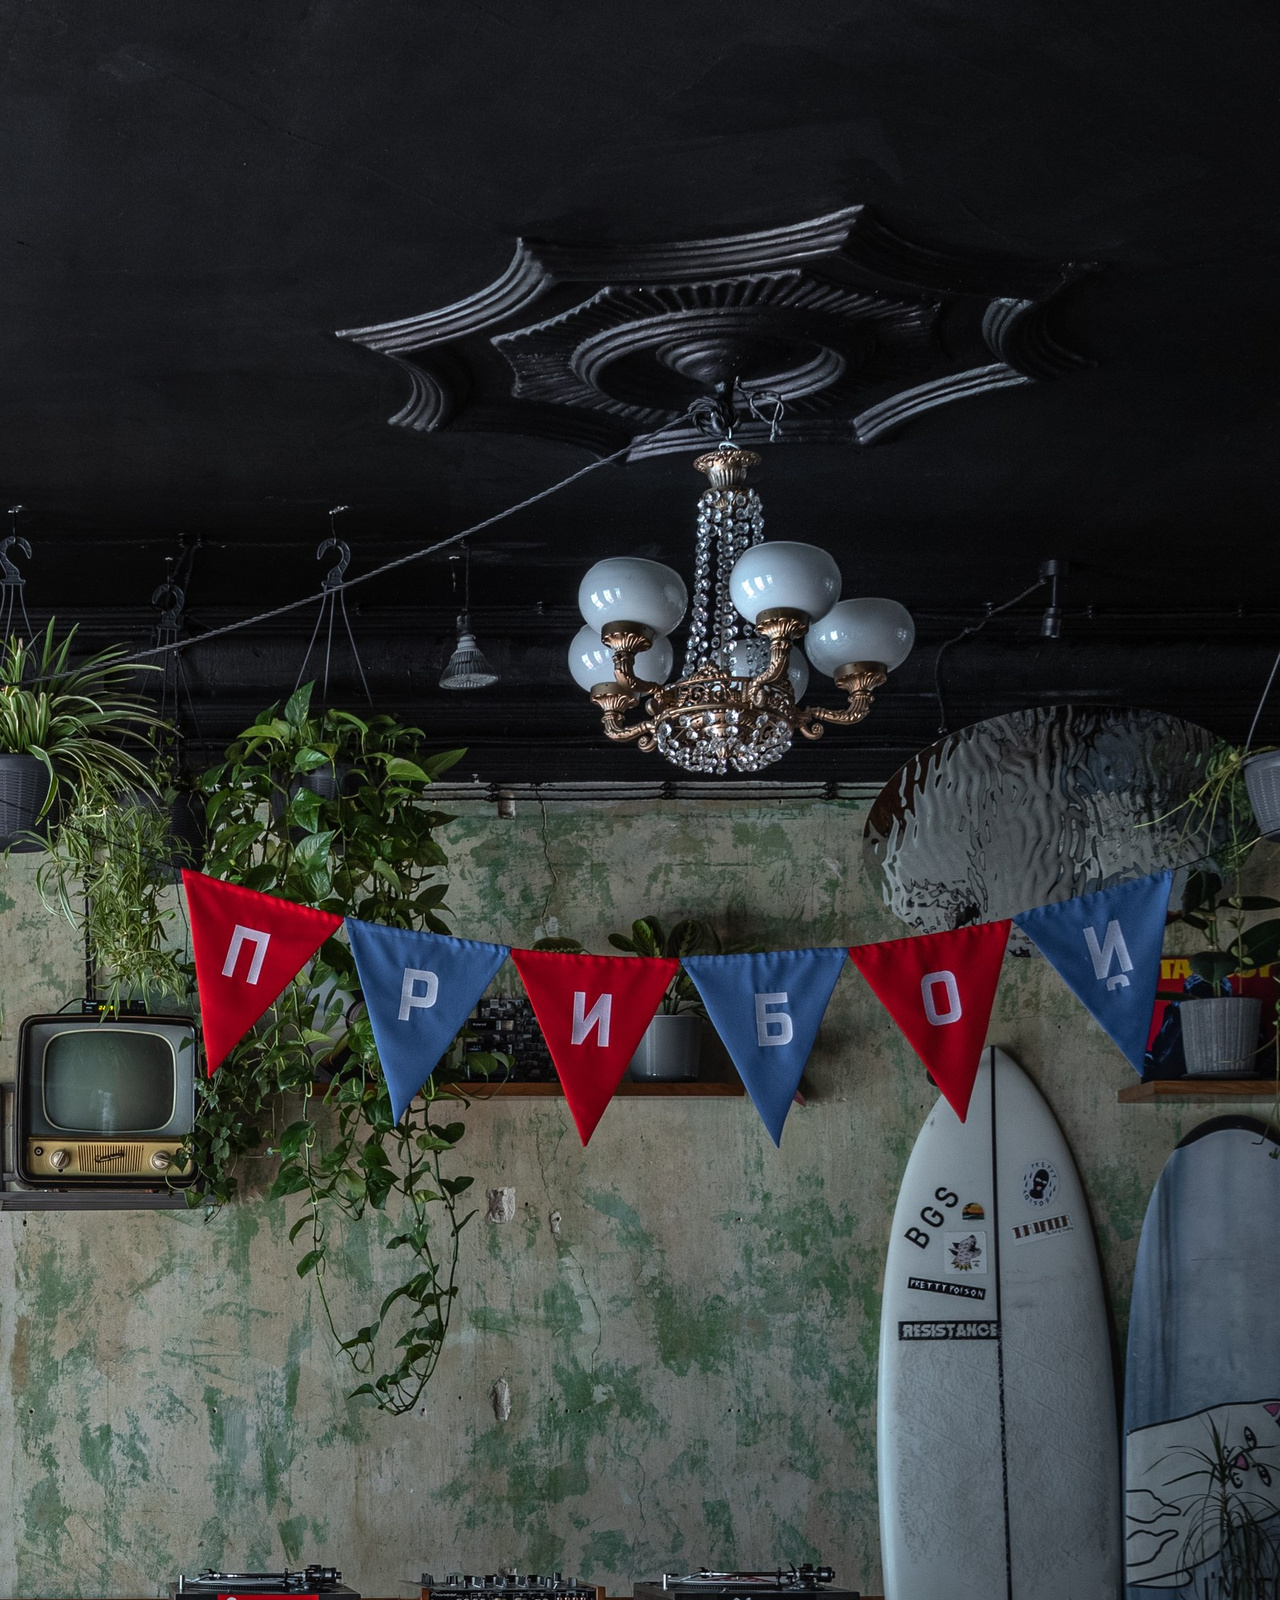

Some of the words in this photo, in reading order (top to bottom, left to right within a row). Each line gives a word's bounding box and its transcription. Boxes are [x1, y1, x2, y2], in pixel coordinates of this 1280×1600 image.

[1031, 1161, 1057, 1178] PRETTY
[1023, 1189, 1050, 1207] POISON
[904, 1186, 959, 1249] BGS
[910, 1279, 948, 1291] PRETTY
[949, 1285, 984, 1298] POISON
[902, 1323, 998, 1338] RESISTANCE
